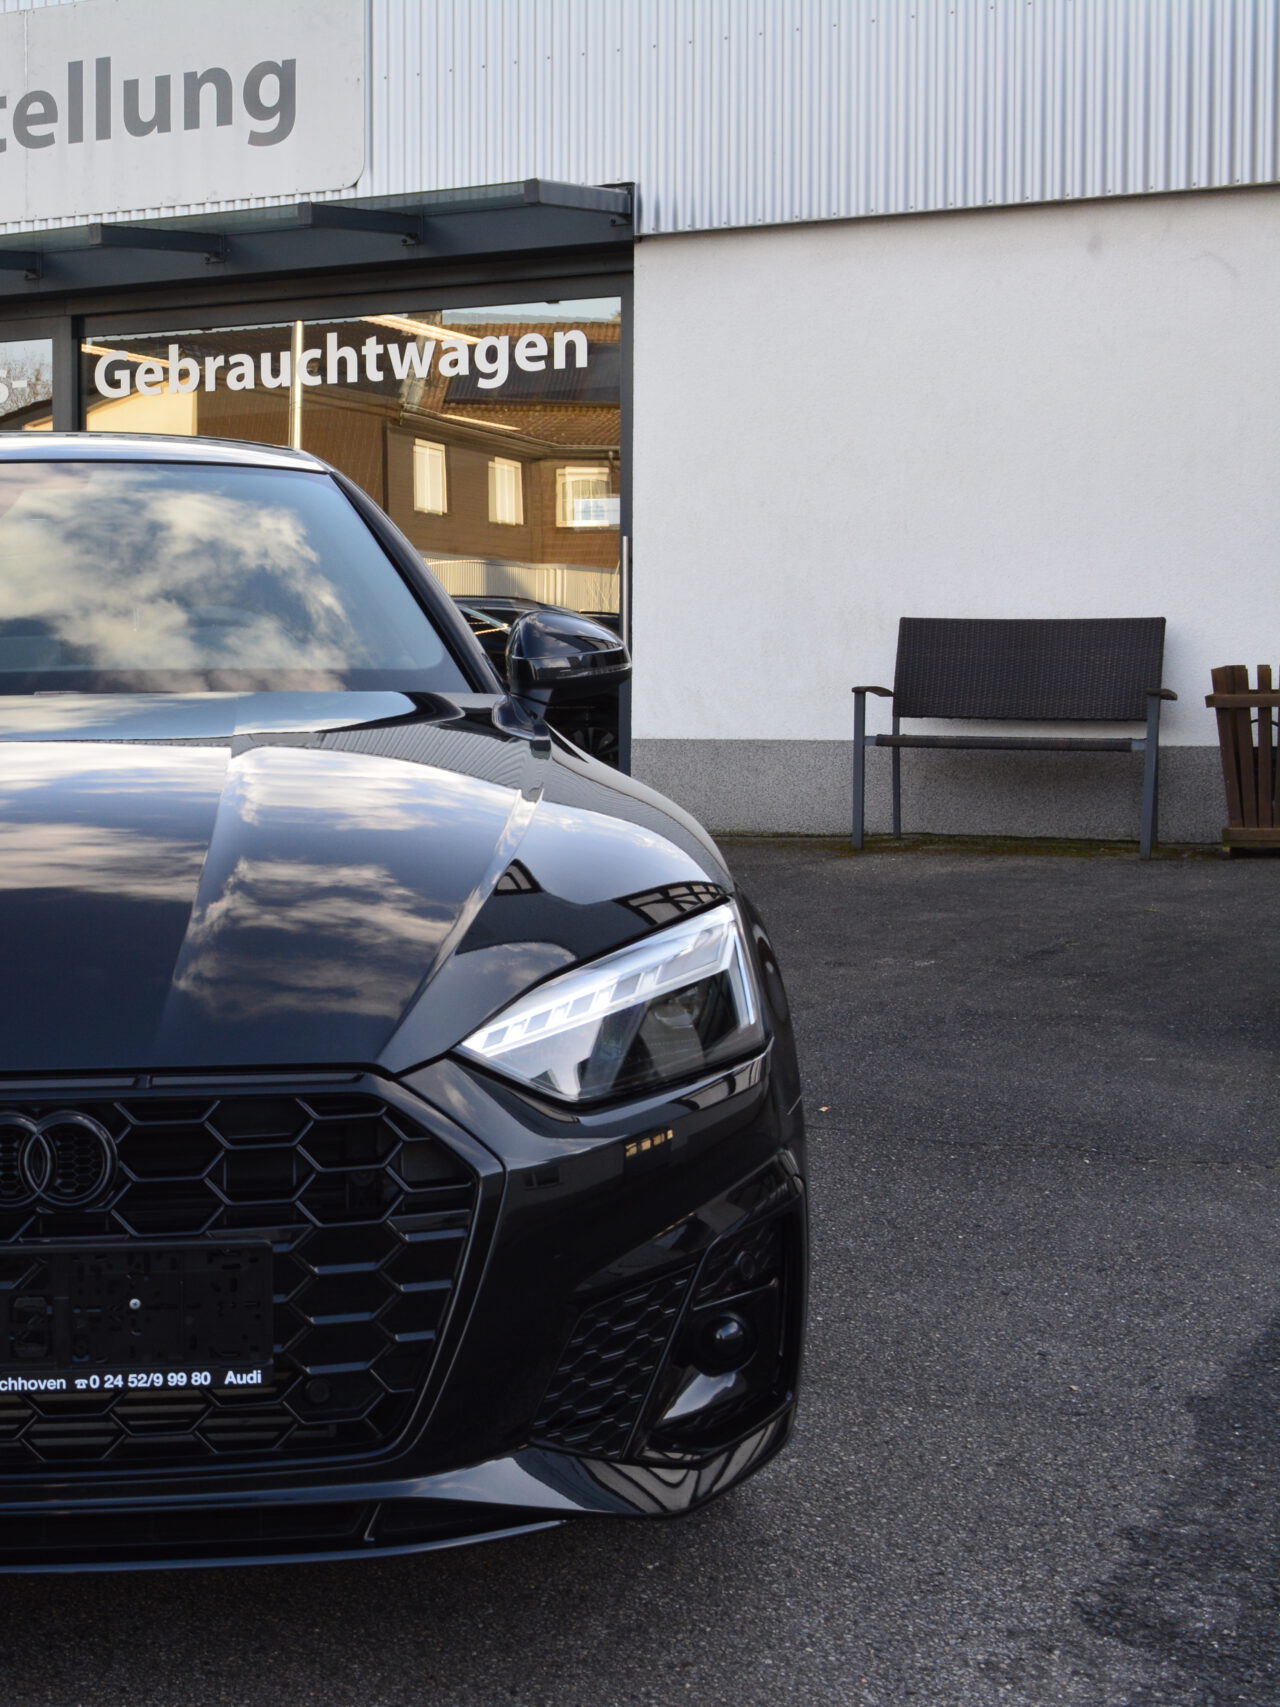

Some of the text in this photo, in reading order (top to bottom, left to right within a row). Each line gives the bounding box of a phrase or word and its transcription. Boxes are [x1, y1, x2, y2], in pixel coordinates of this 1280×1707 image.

[94, 328, 589, 399] Gebrauchtwagen
[103, 1374, 124, 1389] 24
[127, 1372, 164, 1388] 52/9
[166, 1371, 188, 1387] 99
[190, 1371, 212, 1386] 80
[224, 1370, 262, 1385] Audi
